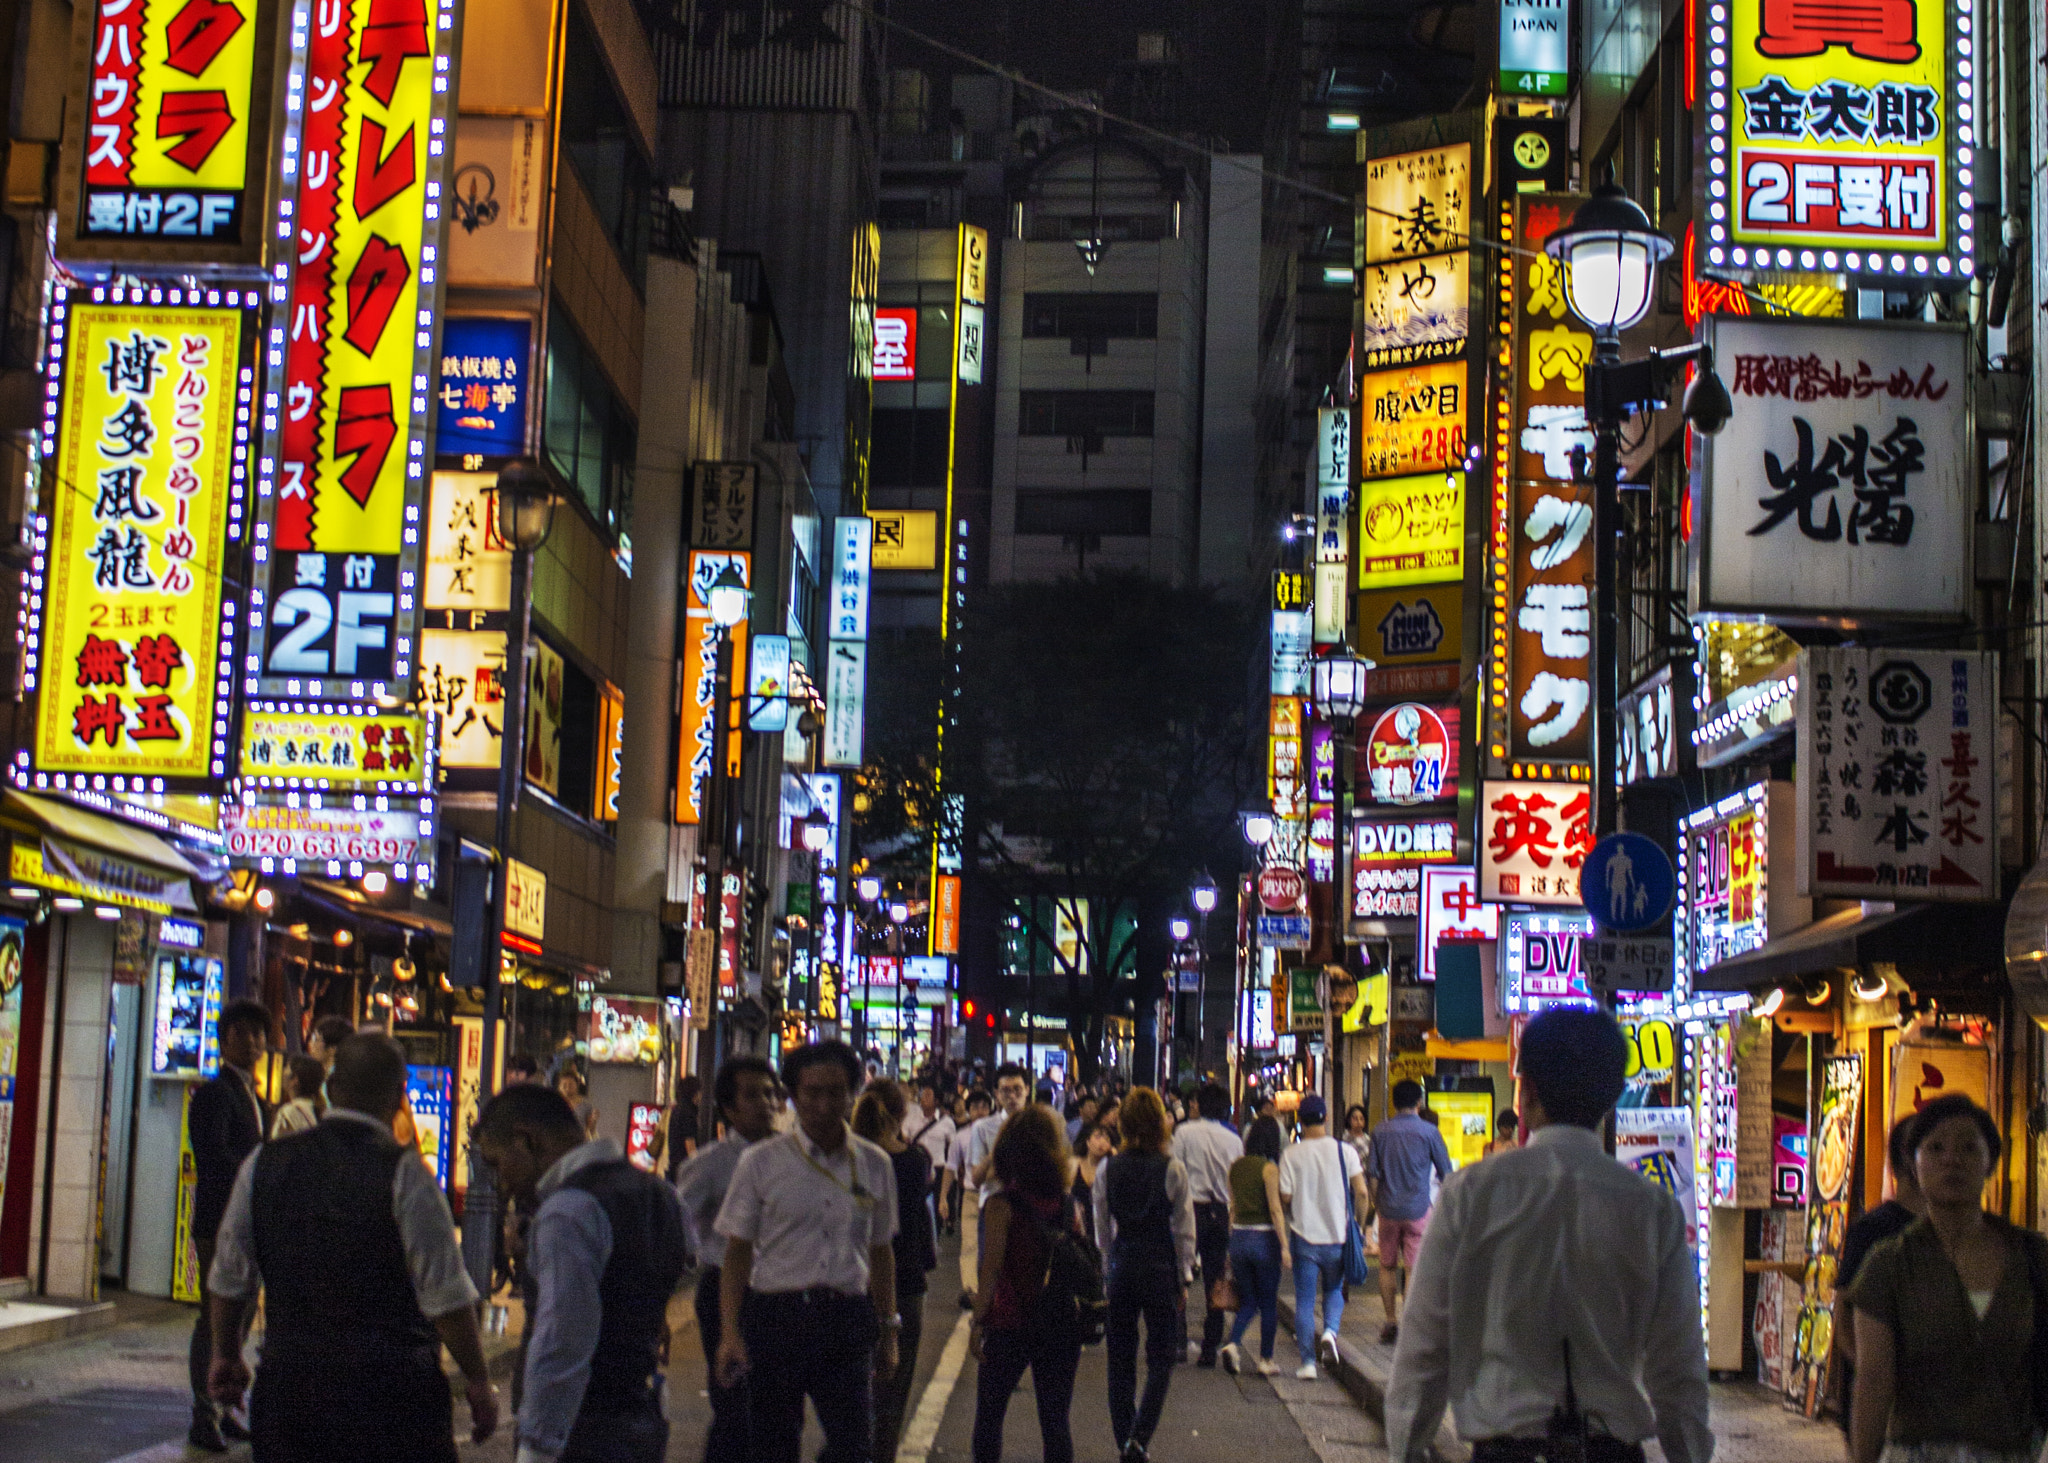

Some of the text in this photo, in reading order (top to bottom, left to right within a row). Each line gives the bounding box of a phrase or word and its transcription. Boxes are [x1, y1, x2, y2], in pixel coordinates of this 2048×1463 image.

[1513, 18, 1558, 32] JAPAN
[1518, 73, 1550, 92] 4F
[1738, 73, 1941, 146] 金太郎
[1746, 161, 1930, 229] 2F受付
[88, 193, 235, 236] 受付2F
[441, 356, 517, 380] 鉄板焼き
[1374, 385, 1459, 424] 腹八分目
[87, 333, 208, 593] 博多風龍 とんこつらーめん
[1406, 490, 1458, 514] やきとり
[1406, 518, 1461, 538] センター
[295, 553, 376, 588] 受付
[90, 604, 178, 628] 2玉まで
[271, 588, 394, 675] 2F
[1872, 748, 1930, 853] 森本
[1531, 876, 1582, 897] 道玄
